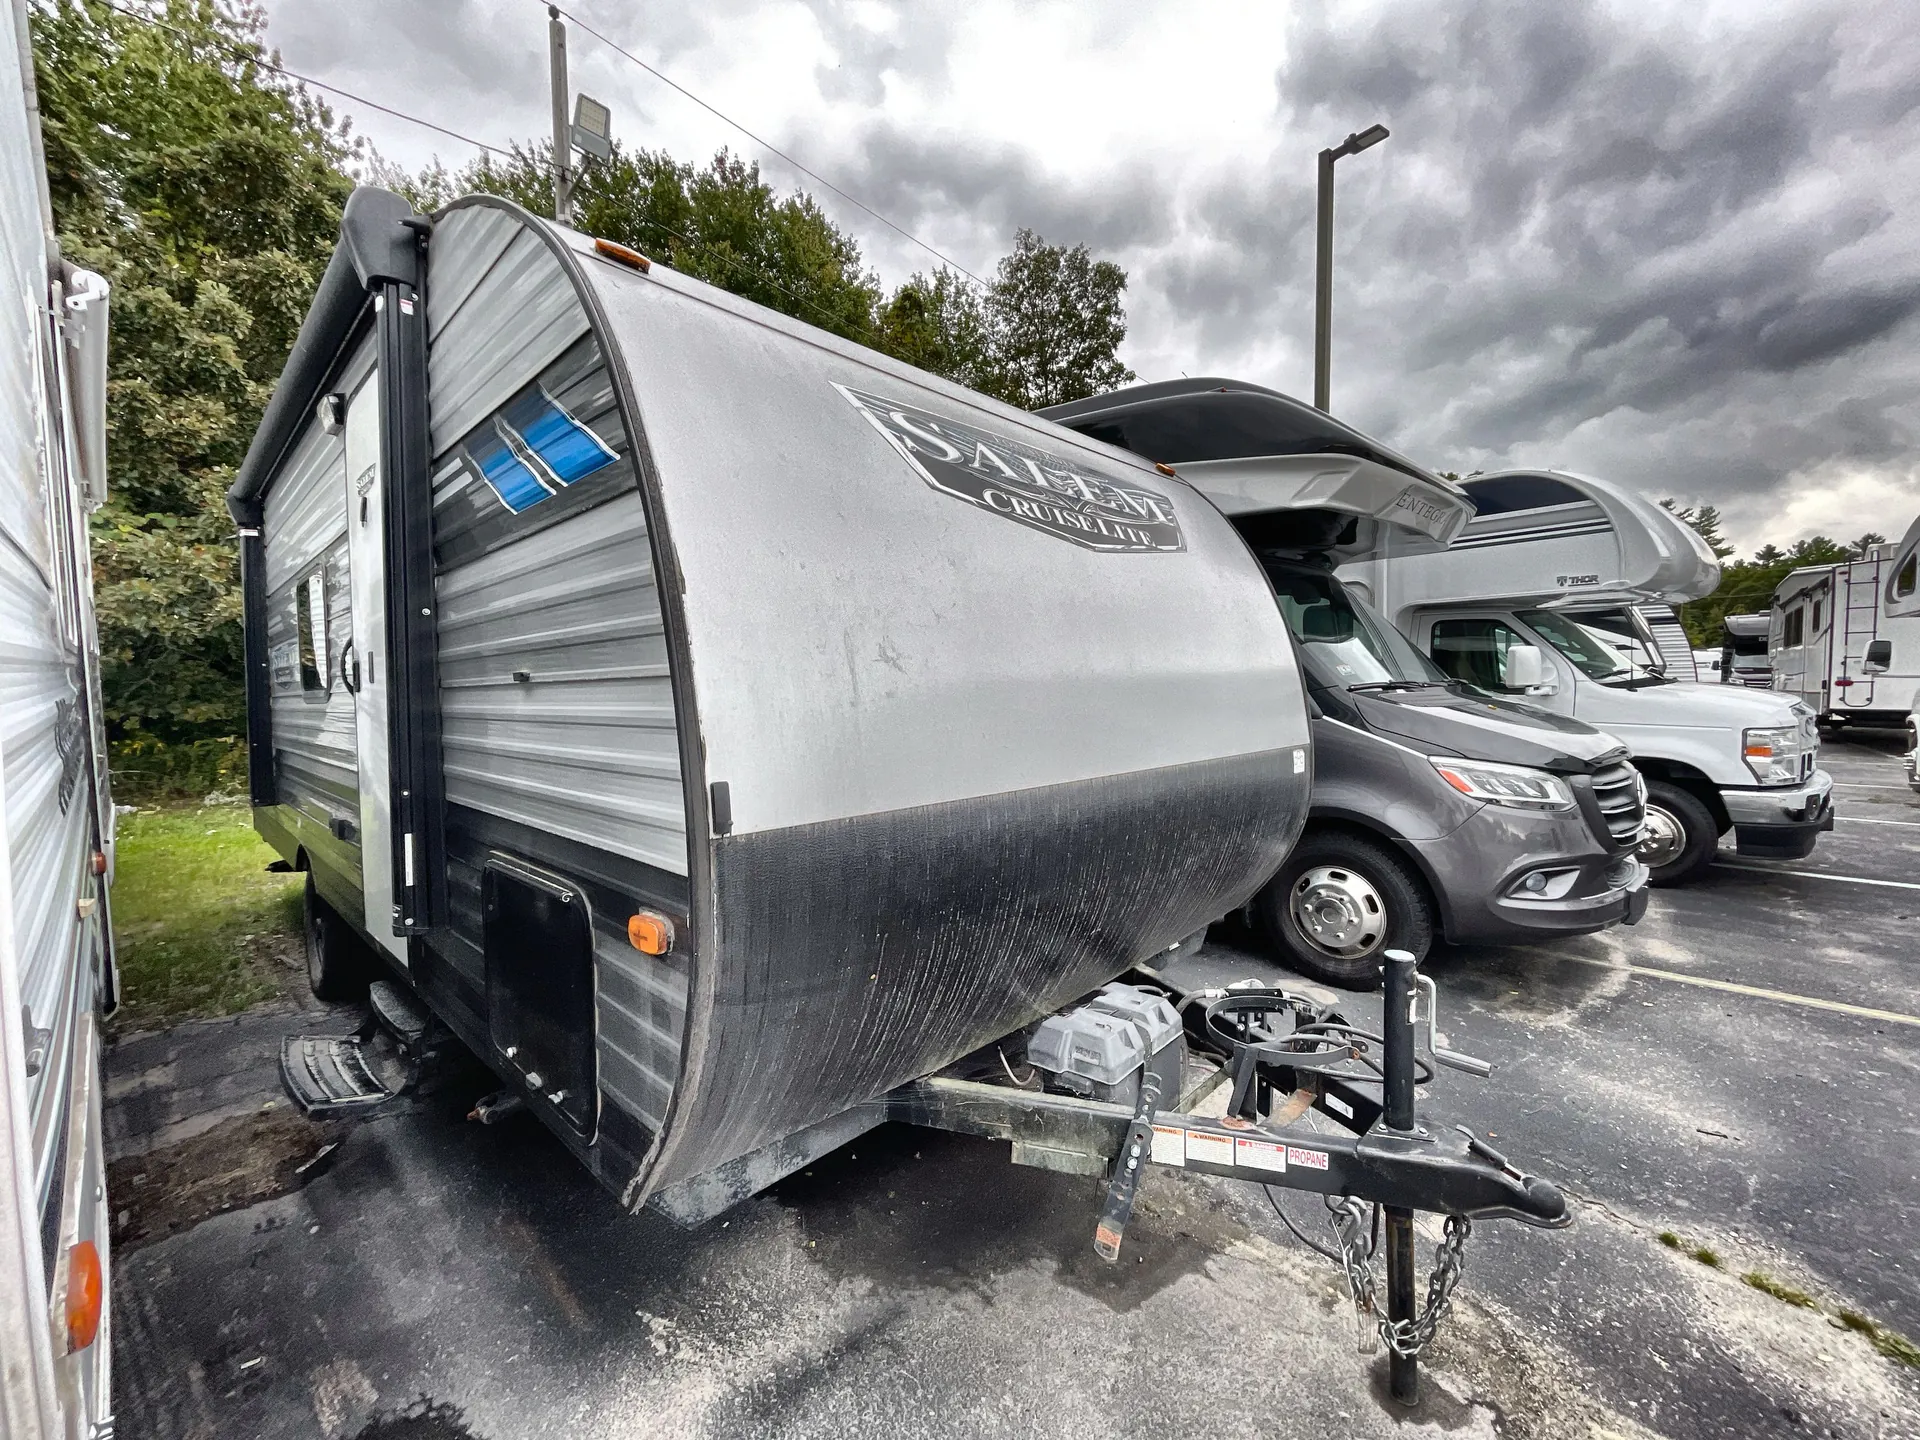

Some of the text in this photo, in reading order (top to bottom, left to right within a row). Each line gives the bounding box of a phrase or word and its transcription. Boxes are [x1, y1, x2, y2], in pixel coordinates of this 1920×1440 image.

[888, 409, 1176, 526] SALEM
[1396, 492, 1452, 529] ENTEGRA
[1569, 575, 1599, 584] THOR
[1199, 1134, 1226, 1143] WARNING
[1289, 1148, 1327, 1168] PROPANE
